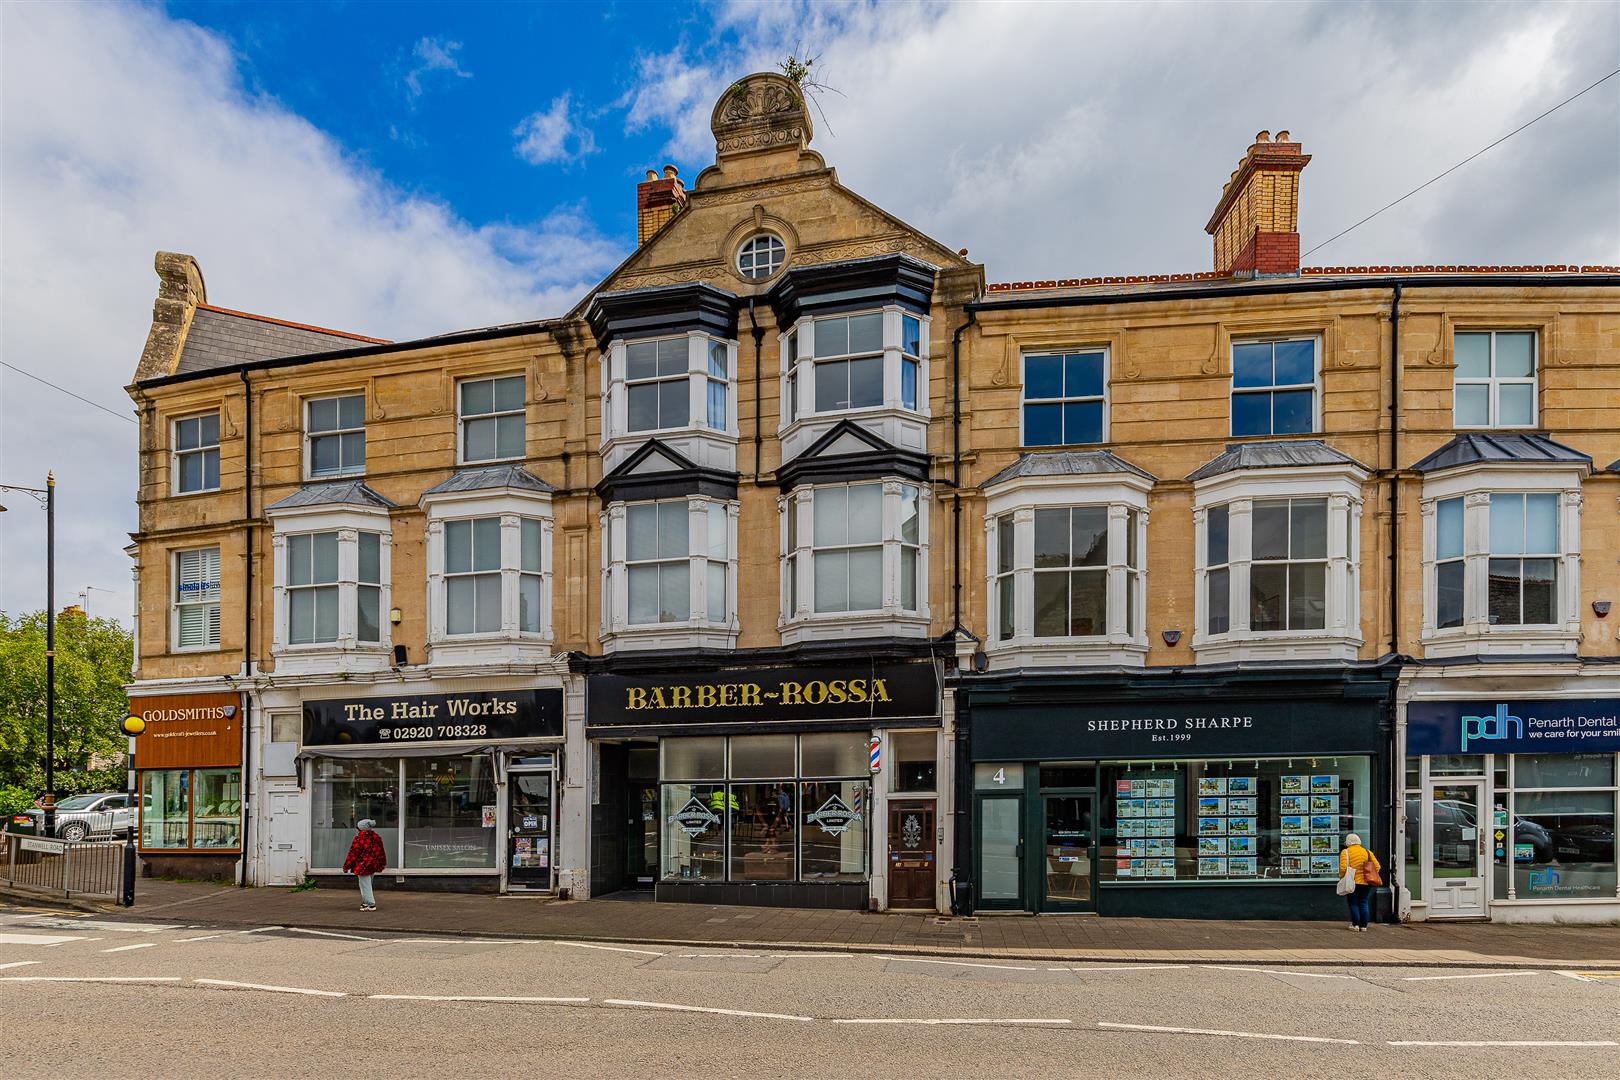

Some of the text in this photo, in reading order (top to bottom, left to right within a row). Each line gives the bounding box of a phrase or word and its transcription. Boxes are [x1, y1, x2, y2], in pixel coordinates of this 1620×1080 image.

[143, 707, 224, 722] GOLDSMITHS
[344, 698, 517, 721] The Hair Works
[1087, 717, 1253, 731] SHEPHERD SHARPE
[1461, 703, 1523, 752] pdh
[1528, 716, 1617, 728] Penarth Dental
[393, 724, 487, 739] 02920 708328
[1151, 734, 1192, 742] Est.1999
[1566, 729, 1580, 738] for
[1580, 730, 1602, 739] your
[993, 767, 1006, 785] 4
